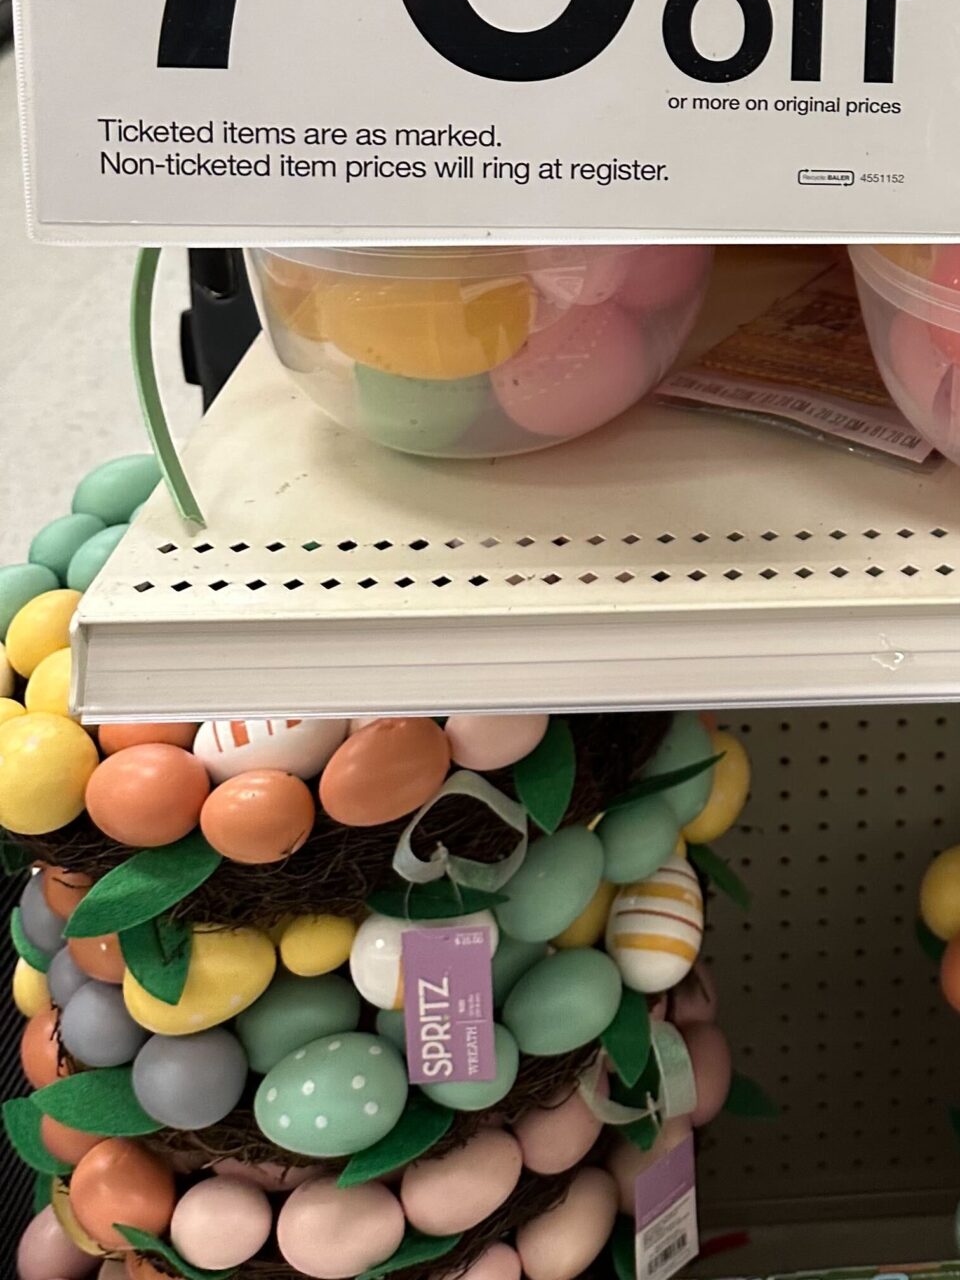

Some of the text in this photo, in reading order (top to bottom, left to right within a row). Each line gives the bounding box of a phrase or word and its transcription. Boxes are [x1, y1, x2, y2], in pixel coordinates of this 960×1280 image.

[668, 96, 901, 117] or more on original prices
[98, 118, 502, 148] Ticketed items are as marked.
[100, 151, 670, 186] Non-ticketed item prices will ring at register.
[860, 173, 905, 184] 4551152
[466, 1026, 479, 1075] WREATH
